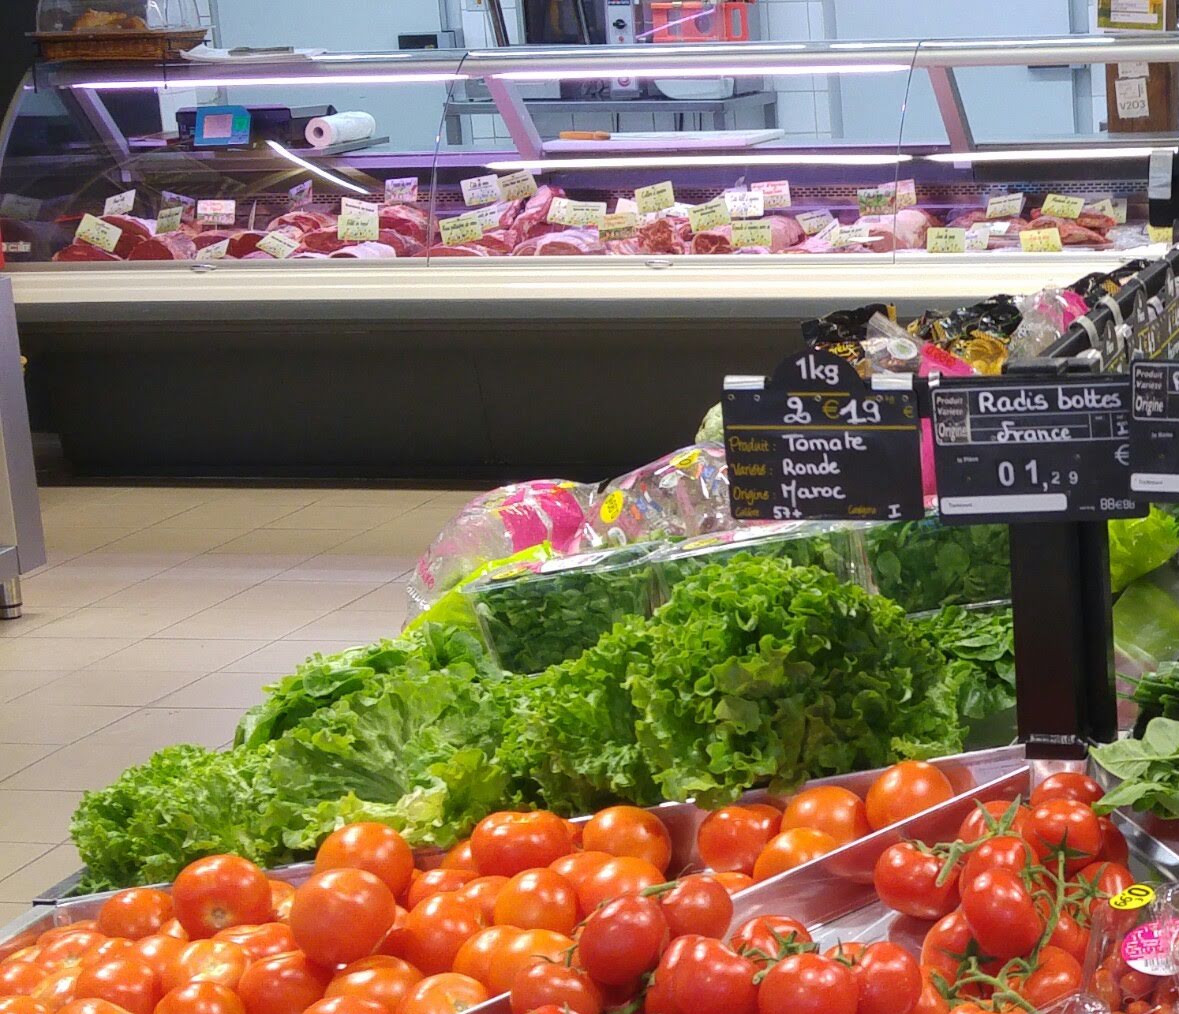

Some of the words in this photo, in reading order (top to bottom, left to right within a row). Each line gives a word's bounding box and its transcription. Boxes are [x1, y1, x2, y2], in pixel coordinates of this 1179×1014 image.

[795, 354, 839, 385] 1kg
[979, 390, 1048, 413] Radis
[1058, 386, 1122, 410] bottes
[1135, 396, 1164, 416] Origine
[782, 431, 867, 452] Tomate
[938, 425, 968, 442] Origine
[783, 453, 840, 475] Ronde
[781, 480, 846, 507] Maroc
